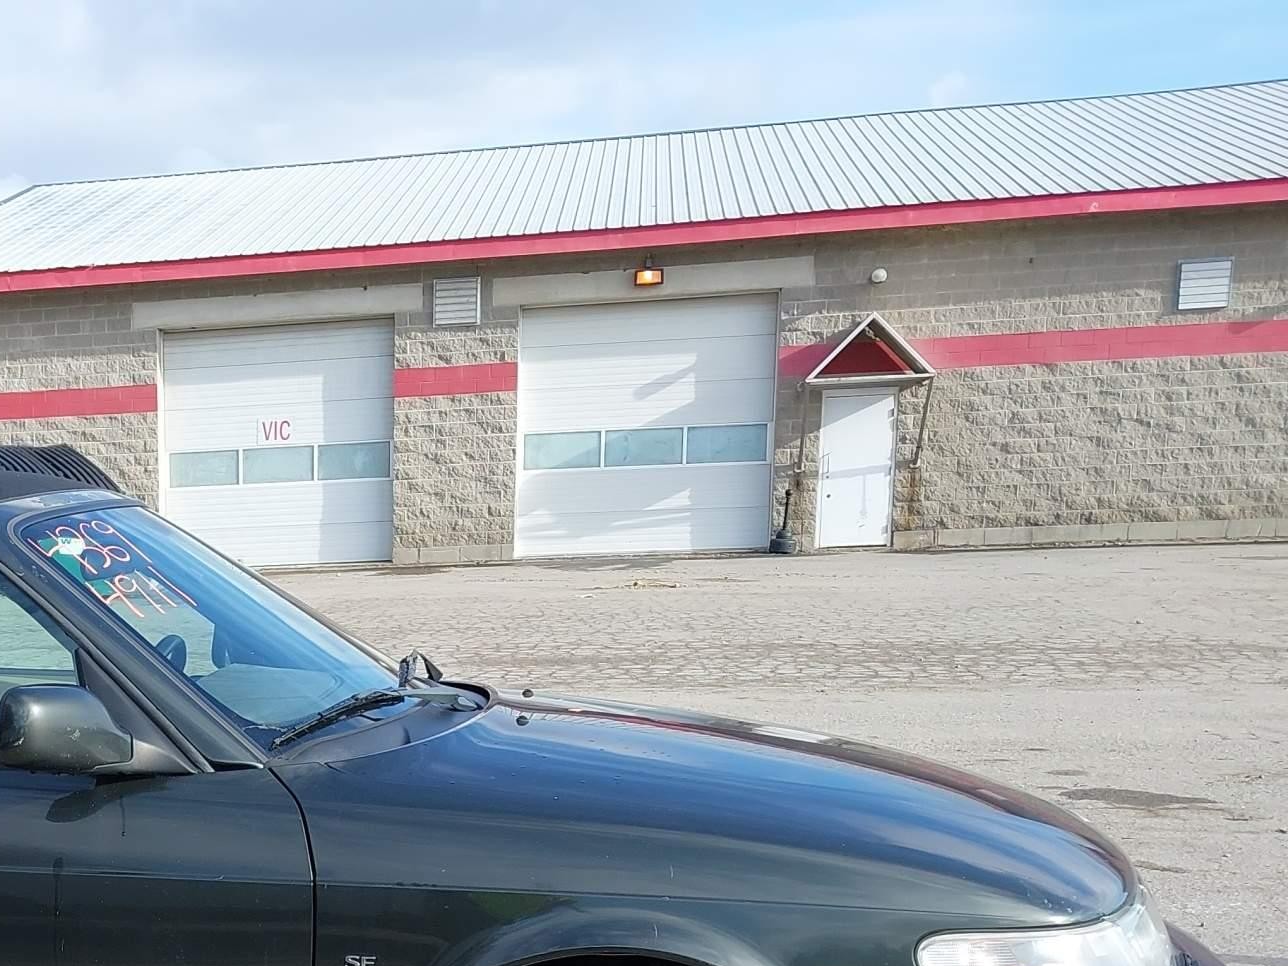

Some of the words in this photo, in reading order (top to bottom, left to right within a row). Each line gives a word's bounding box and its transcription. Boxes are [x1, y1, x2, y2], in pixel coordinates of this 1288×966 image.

[262, 420, 291, 441] VIC
[26, 520, 153, 575] 4369
[85, 566, 198, 618] 4911
